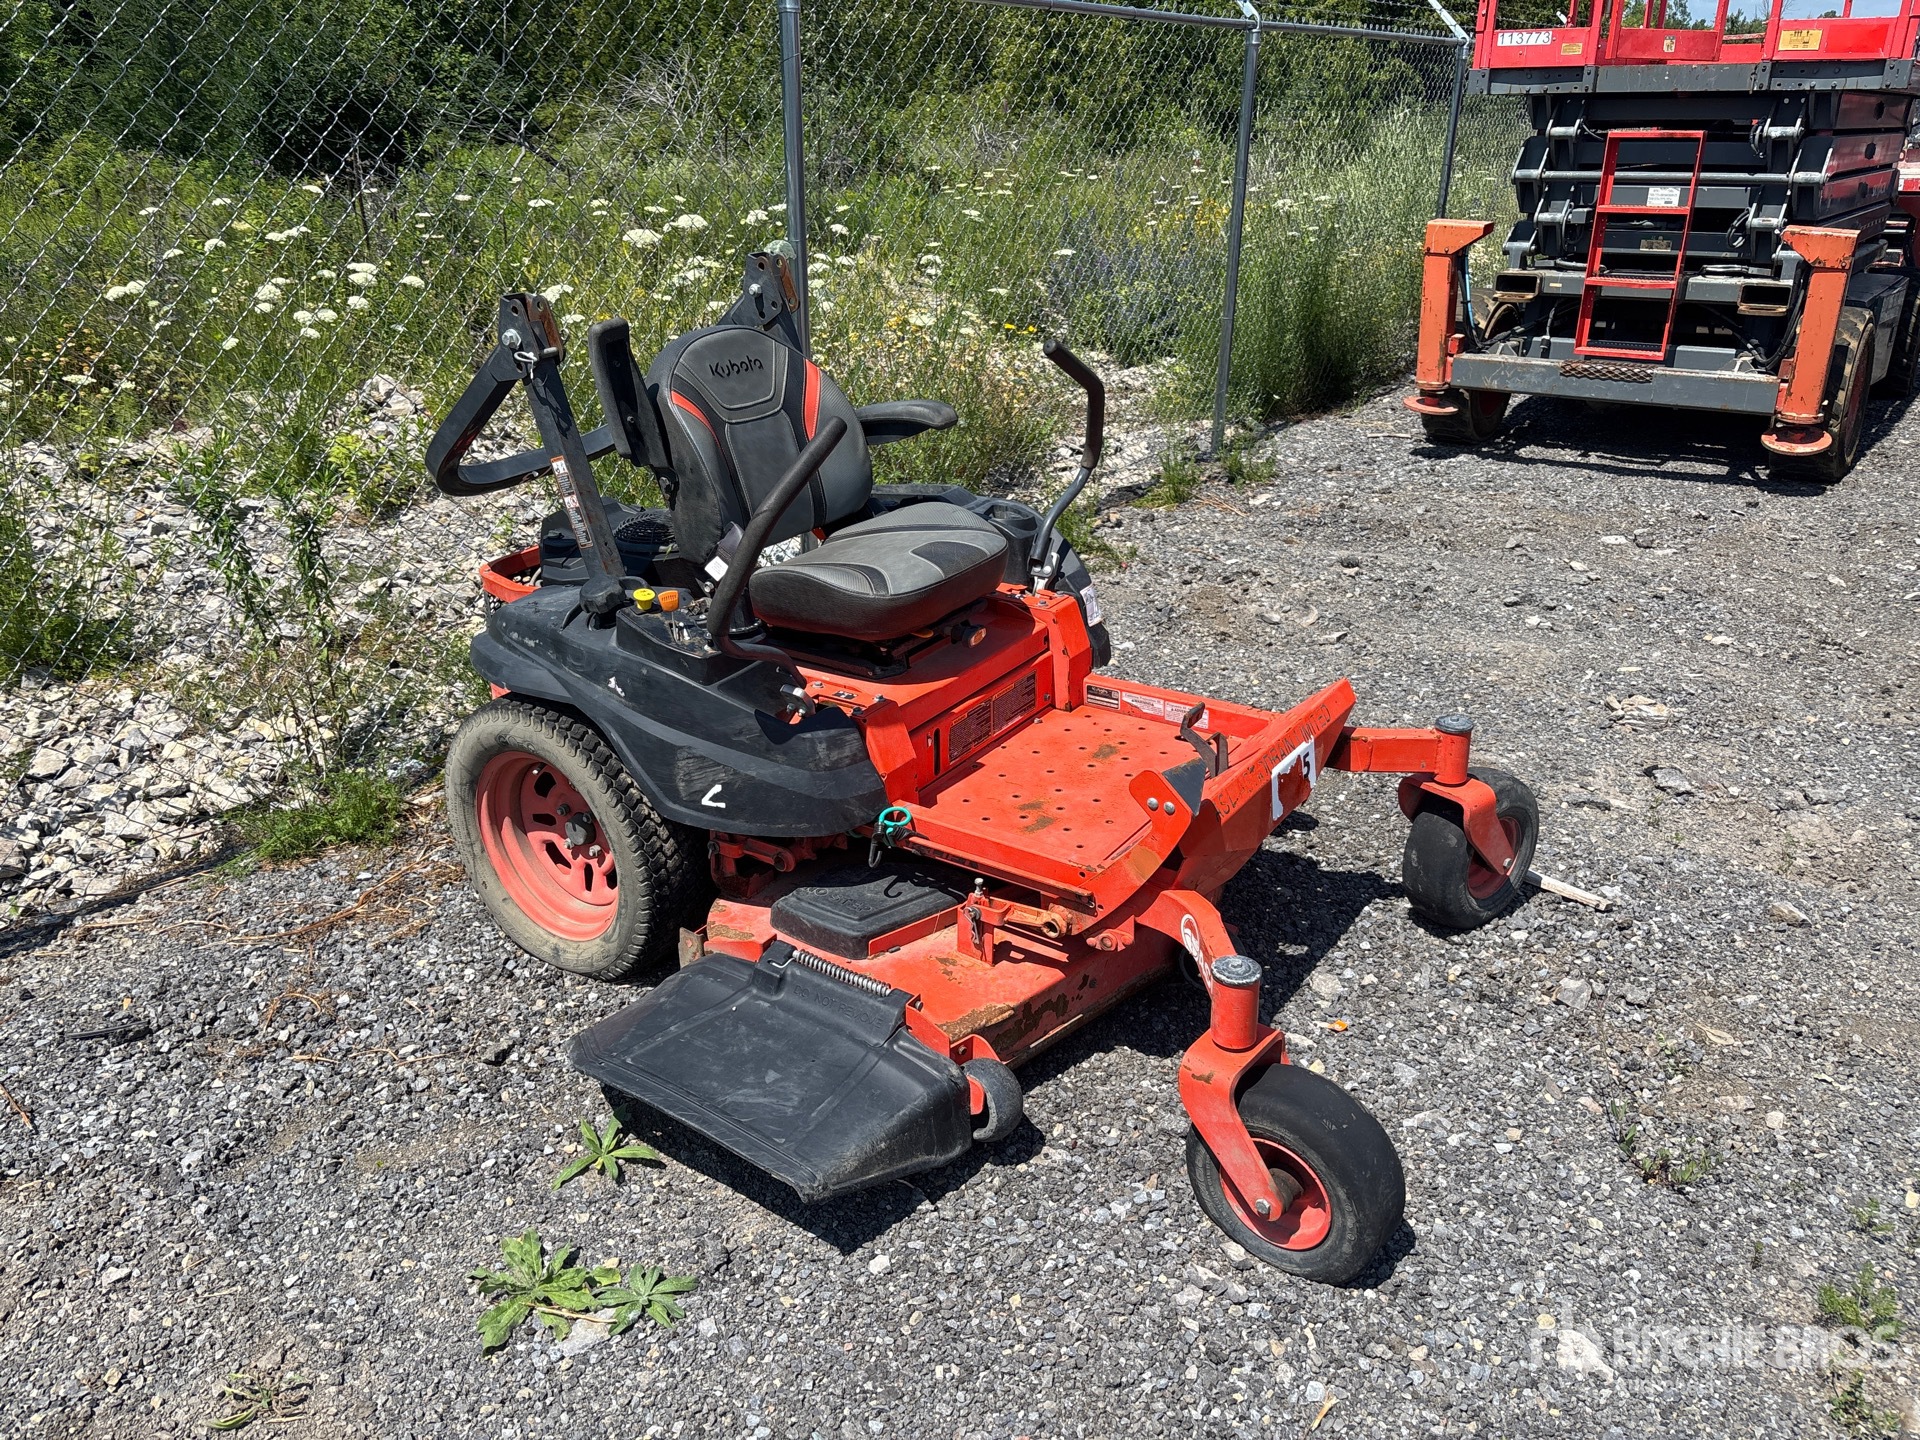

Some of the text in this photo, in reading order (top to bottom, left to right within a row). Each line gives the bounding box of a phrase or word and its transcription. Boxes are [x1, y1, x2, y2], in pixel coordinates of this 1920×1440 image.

[1500, 32, 1550, 44] 113773
[709, 355, 764, 378] Kubota
[794, 984, 810, 998] DO
